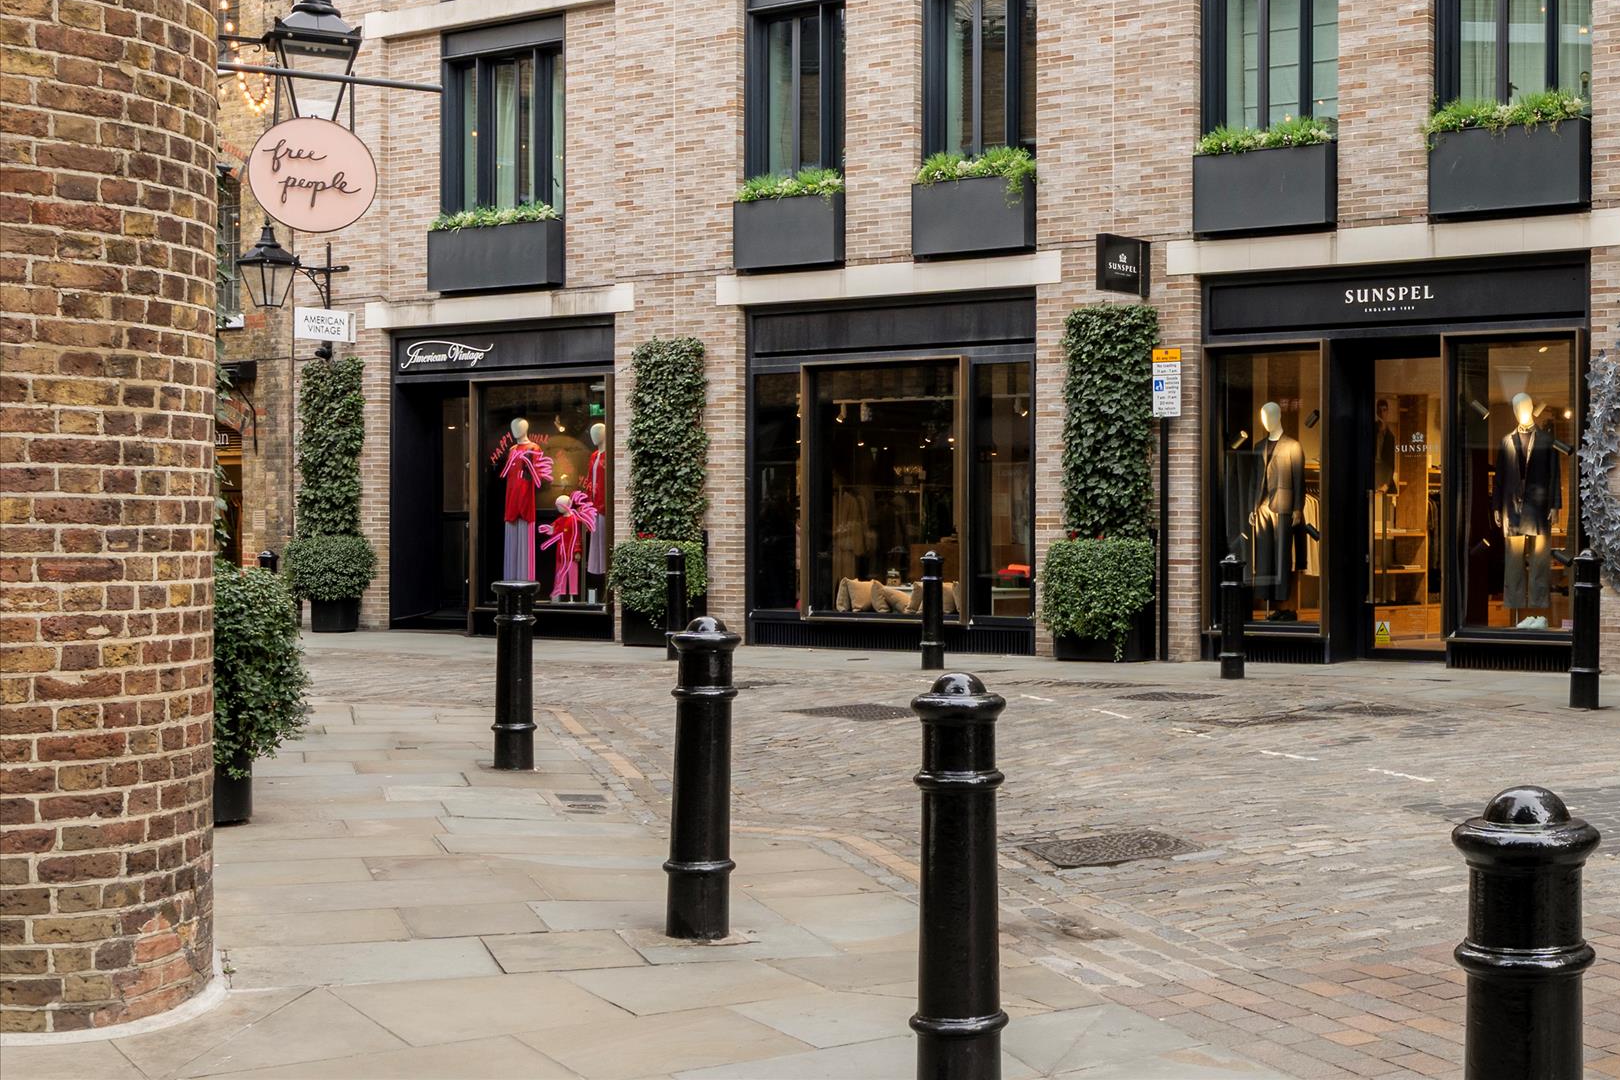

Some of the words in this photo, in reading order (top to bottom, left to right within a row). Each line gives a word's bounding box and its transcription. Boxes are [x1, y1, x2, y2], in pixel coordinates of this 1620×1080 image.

[262, 139, 327, 173] free
[278, 171, 362, 208] people
[1108, 261, 1137, 274] SUNSPEL
[1344, 285, 1434, 304] SUNSPEL
[304, 315, 345, 326] AMERICAN
[307, 324, 341, 336] VINTAGE
[401, 340, 448, 369] American
[447, 343, 489, 366] Vintage
